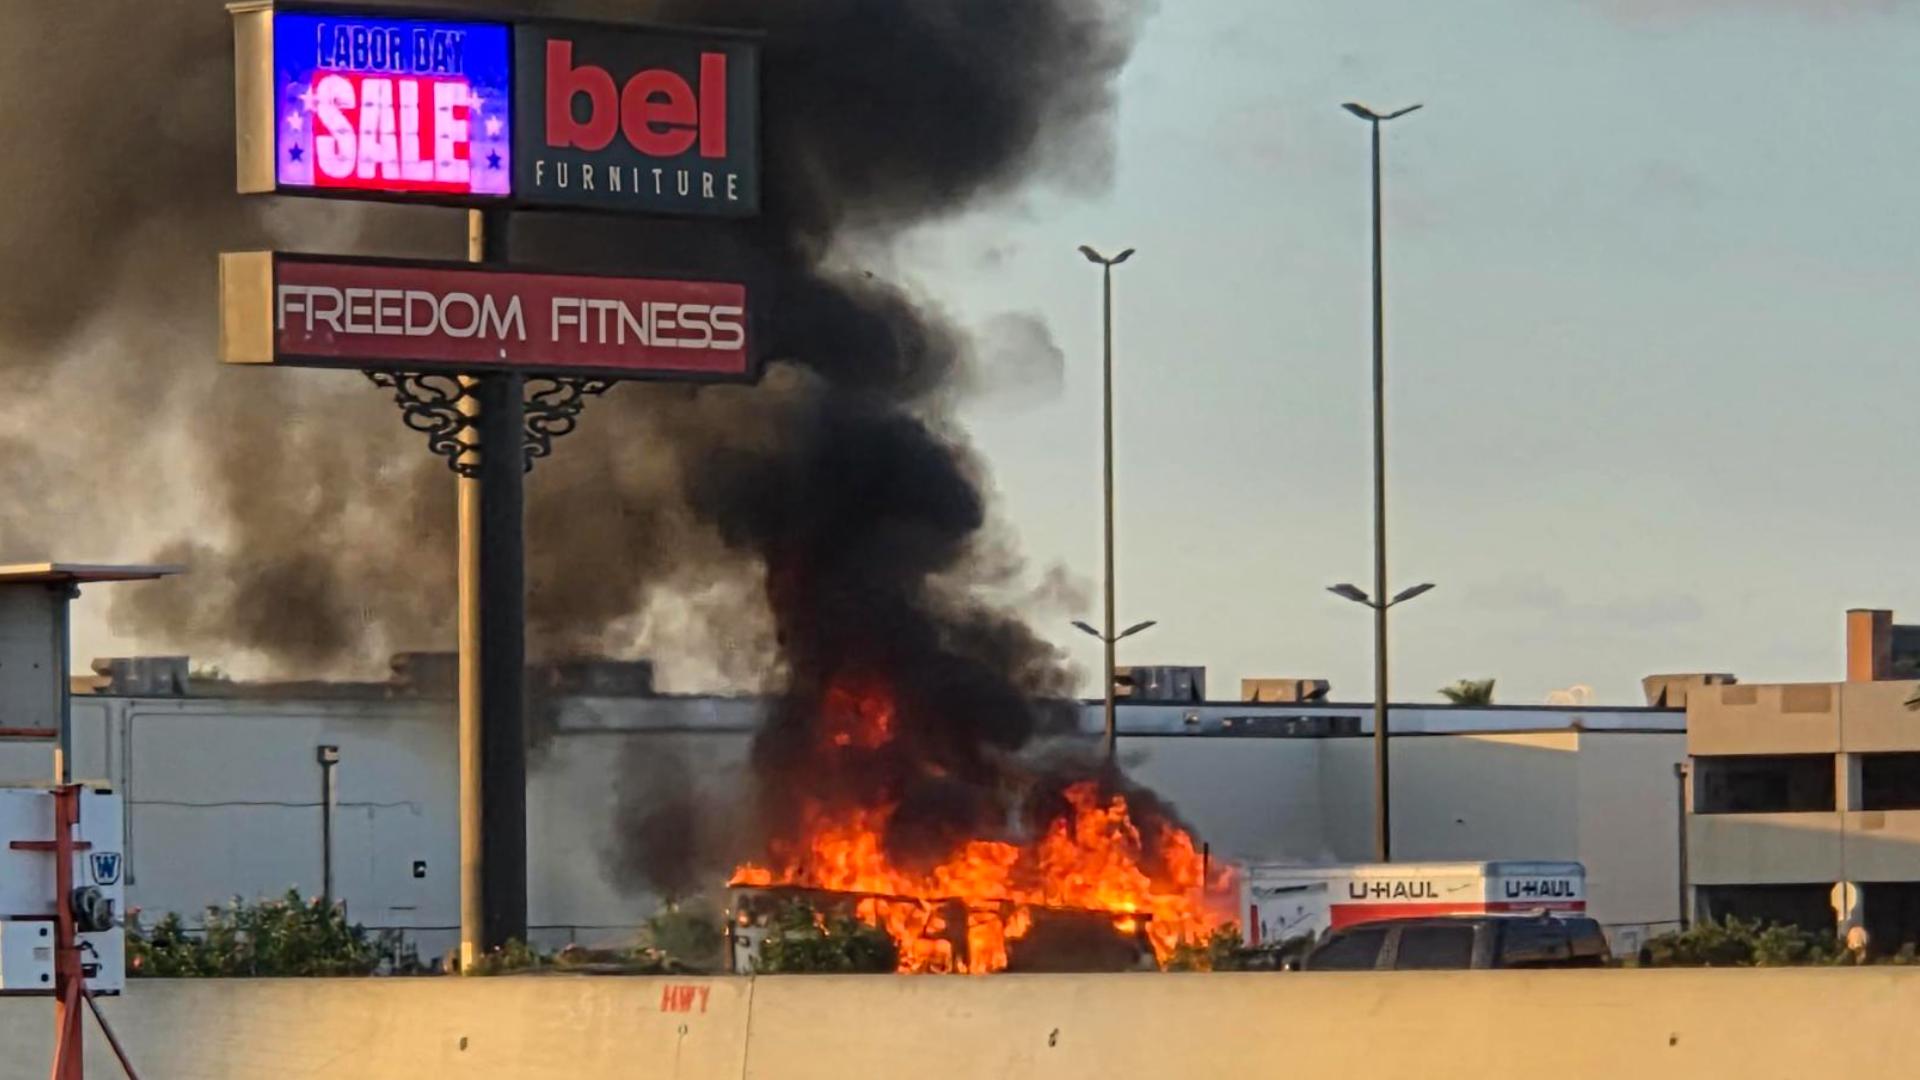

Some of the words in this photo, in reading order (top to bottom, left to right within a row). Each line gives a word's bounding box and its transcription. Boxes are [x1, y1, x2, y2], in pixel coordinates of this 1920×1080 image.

[317, 24, 402, 70] LABOR
[413, 28, 467, 73] DAY
[546, 39, 727, 158] bel
[314, 75, 470, 183] SALE
[536, 160, 738, 201] FURNITURE
[277, 284, 526, 341] FREEDOM
[551, 297, 744, 351] FITNESS
[1349, 880, 1439, 899] U-HAUL
[1505, 880, 1575, 897] U-HAUL
[661, 984, 710, 1013] HWY
